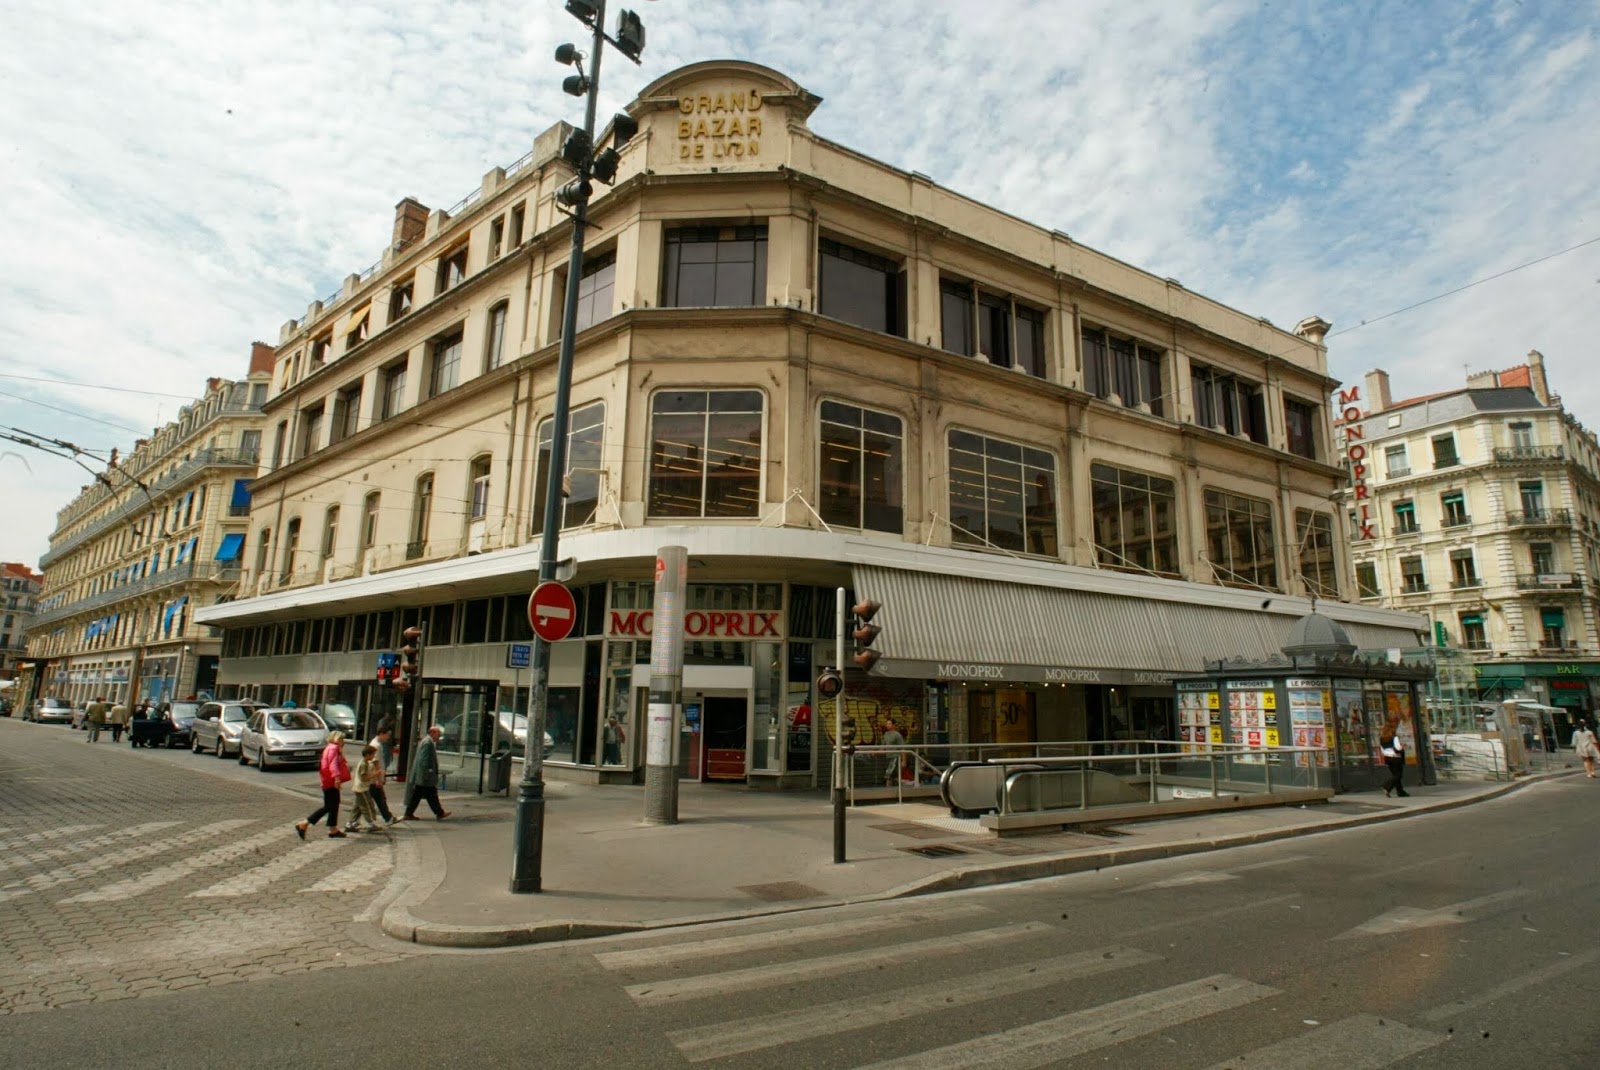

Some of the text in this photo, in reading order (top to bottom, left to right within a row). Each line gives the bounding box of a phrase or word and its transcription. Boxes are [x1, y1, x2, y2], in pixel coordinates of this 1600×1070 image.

[680, 91, 763, 114] GRAND
[678, 117, 762, 139] BAZAR
[680, 141, 759, 159] DE LYON
[1339, 385, 1377, 541] MONOPRIX
[608, 611, 781, 637] MOOPRIX
[938, 664, 1004, 679] MONOPRIX
[1045, 668, 1100, 682] MONOPRIX
[1556, 664, 1580, 674] BAR
